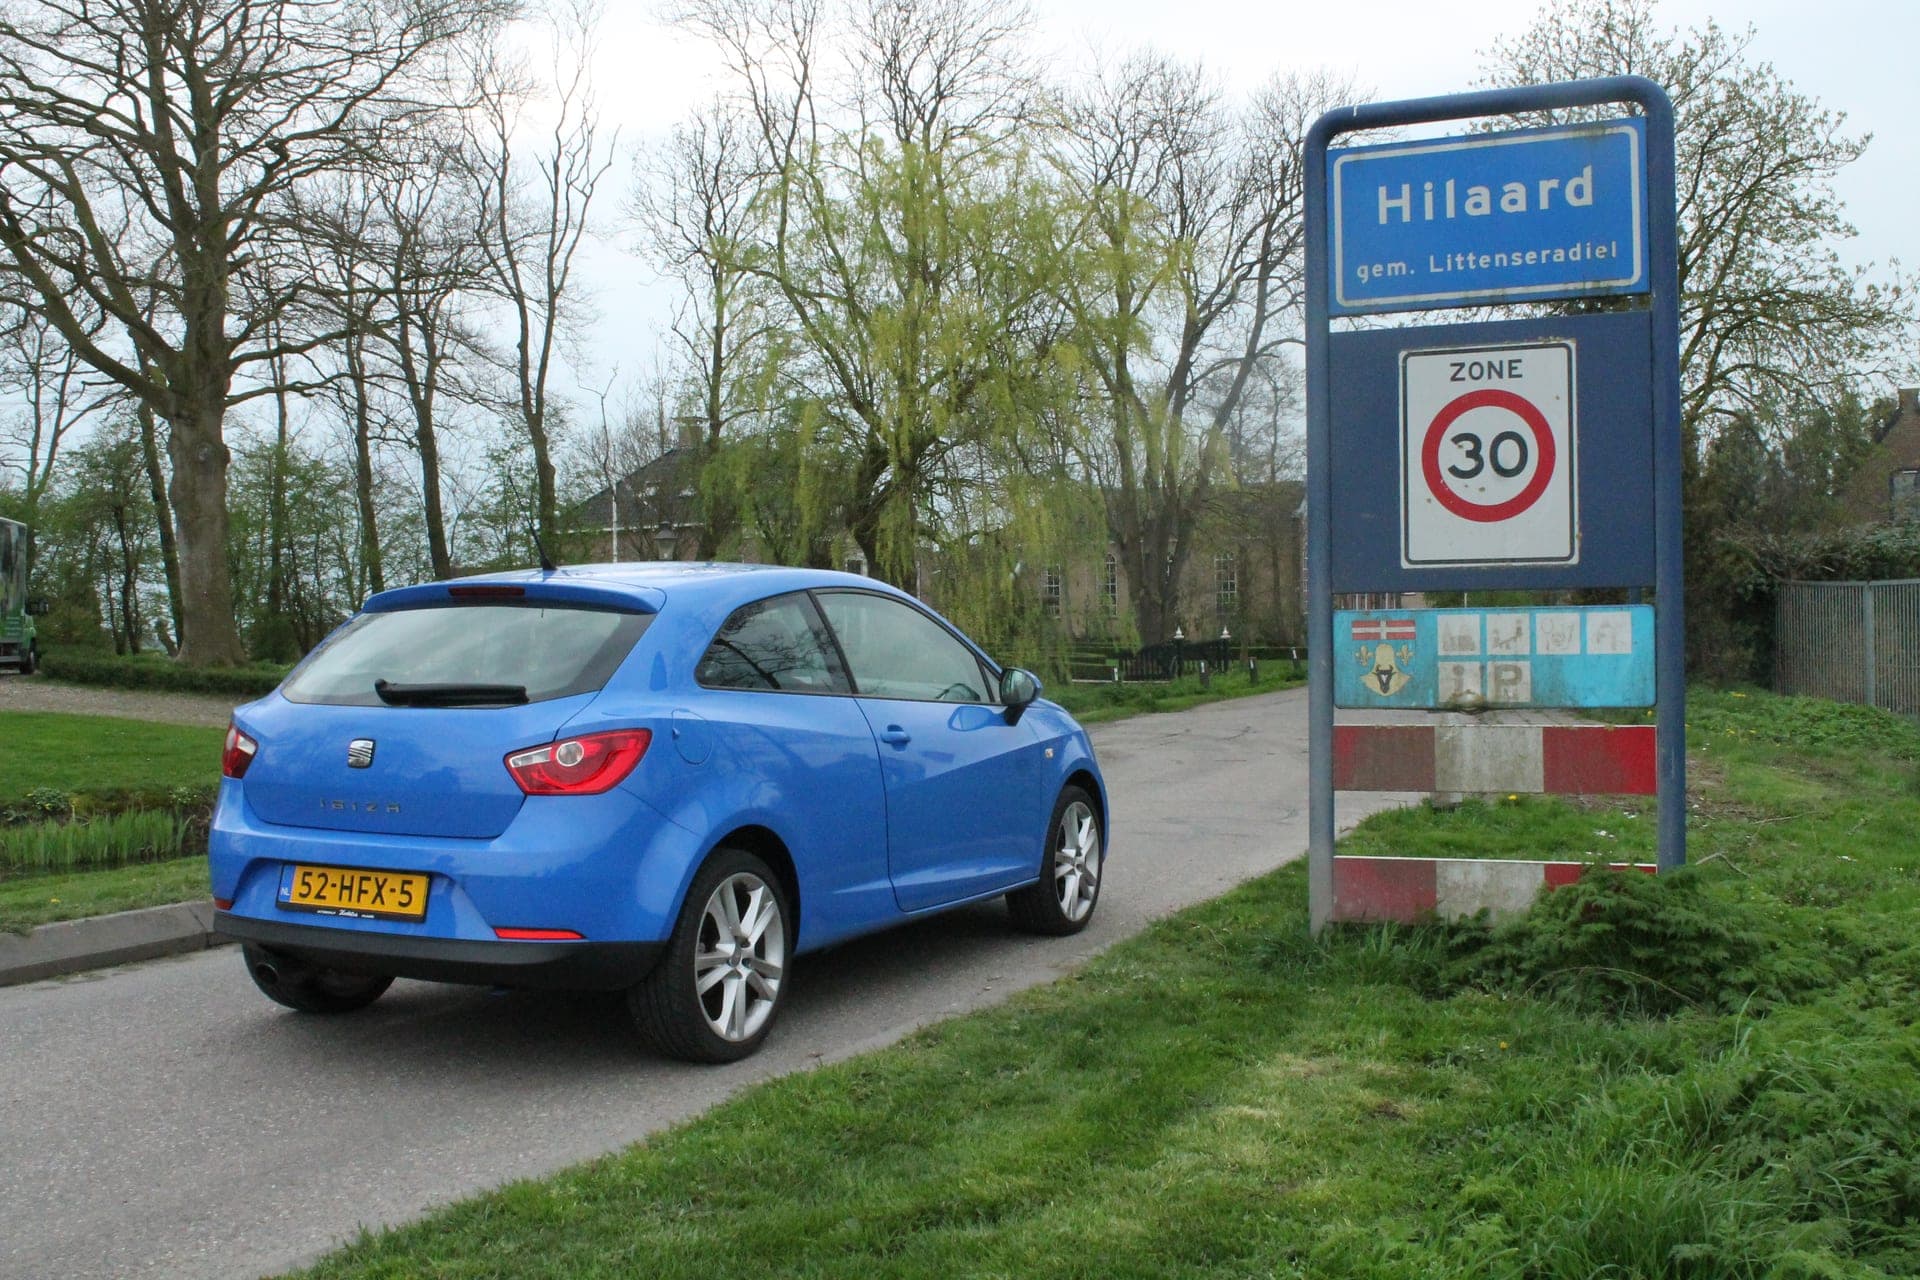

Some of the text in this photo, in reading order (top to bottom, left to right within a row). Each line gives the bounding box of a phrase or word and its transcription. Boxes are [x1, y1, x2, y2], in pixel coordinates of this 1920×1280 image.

[1378, 165, 1593, 225] Hilaard
[1356, 241, 1618, 284] gem. Littenseradiel
[1450, 359, 1522, 381] ZONE
[1448, 431, 1528, 479] 30
[320, 800, 400, 813] IBIZA
[298, 871, 413, 908] 52-HFX-5
